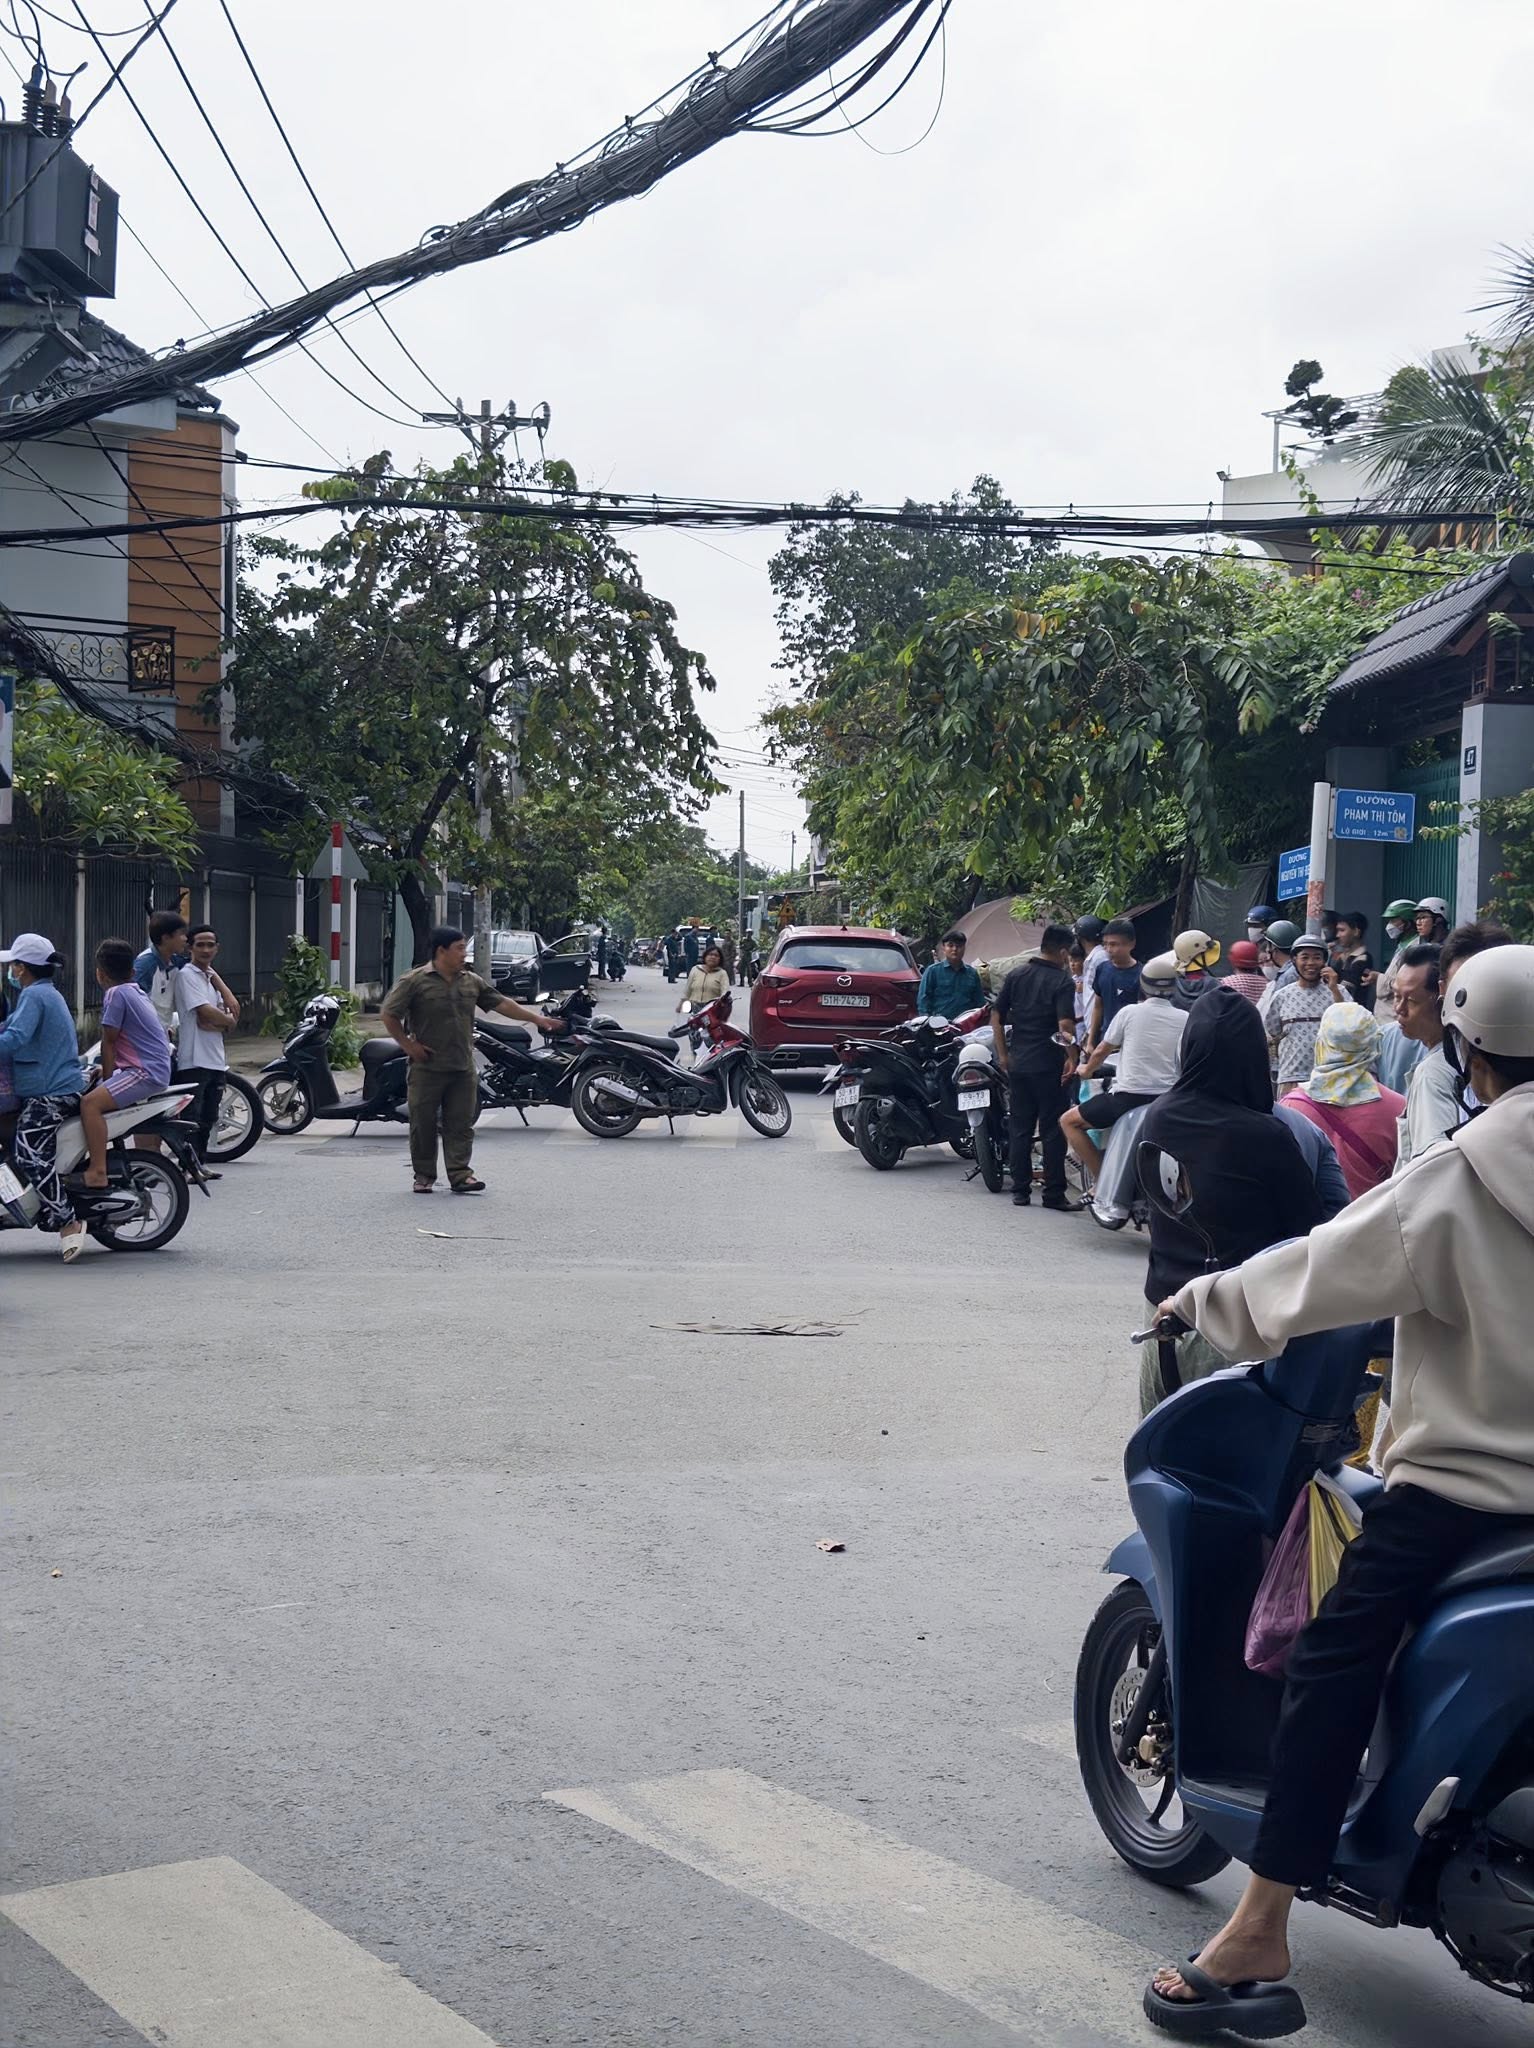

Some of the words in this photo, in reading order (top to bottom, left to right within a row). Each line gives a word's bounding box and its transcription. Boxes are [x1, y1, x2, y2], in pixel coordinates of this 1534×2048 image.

[1356, 795, 1396, 806] ĐƯỜNG
[1344, 808, 1369, 823] PHẠM
[1371, 810, 1385, 825] THỊ
